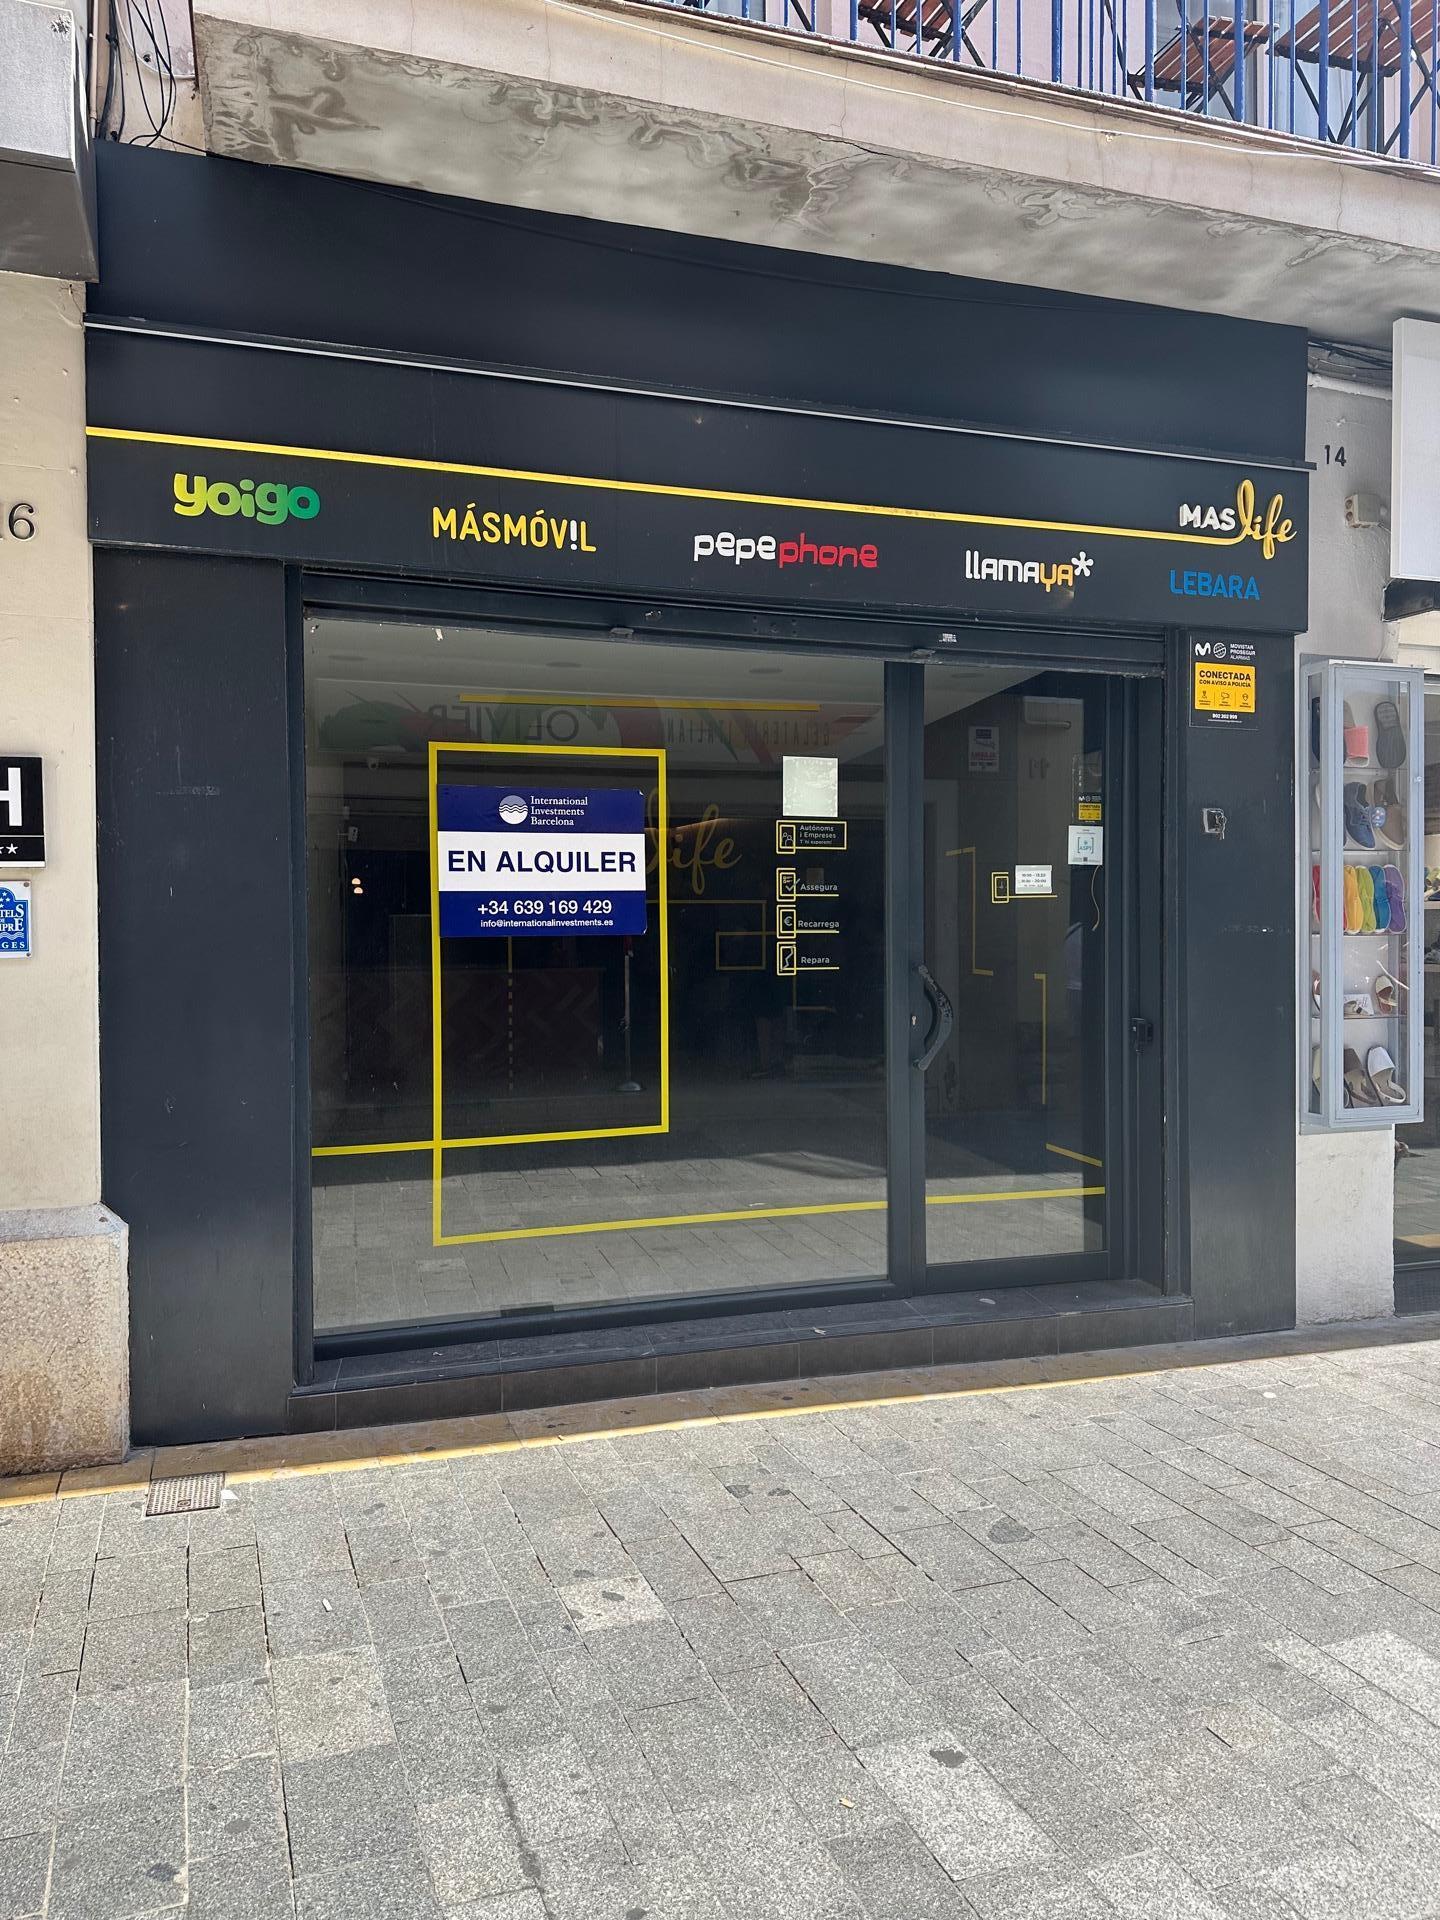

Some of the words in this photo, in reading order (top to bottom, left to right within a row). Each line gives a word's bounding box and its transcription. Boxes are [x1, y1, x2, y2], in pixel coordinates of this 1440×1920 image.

[1324, 444, 1347, 467] 14
[173, 473, 320, 525] yoigo
[0, 502, 35, 541] 6
[693, 531, 878, 569] pepephone
[1169, 569, 1260, 601] LEBARA
[1199, 670, 1252, 681] CONECTADA
[530, 796, 588, 806] International
[530, 806, 585, 816] Investments
[530, 816, 574, 826] Barcelona
[448, 850, 486, 872] EN
[496, 850, 636, 873] ALQUILER
[800, 883, 838, 892] Assegura
[477, 900, 508, 915] +34
[513, 900, 544, 915] 639
[549, 900, 578, 915] 169
[583, 899, 612, 915] 429
[480, 919, 614, 928] info@internationalinvestments.es
[797, 919, 840, 928] Recarrega
[800, 956, 830, 965] Repara
